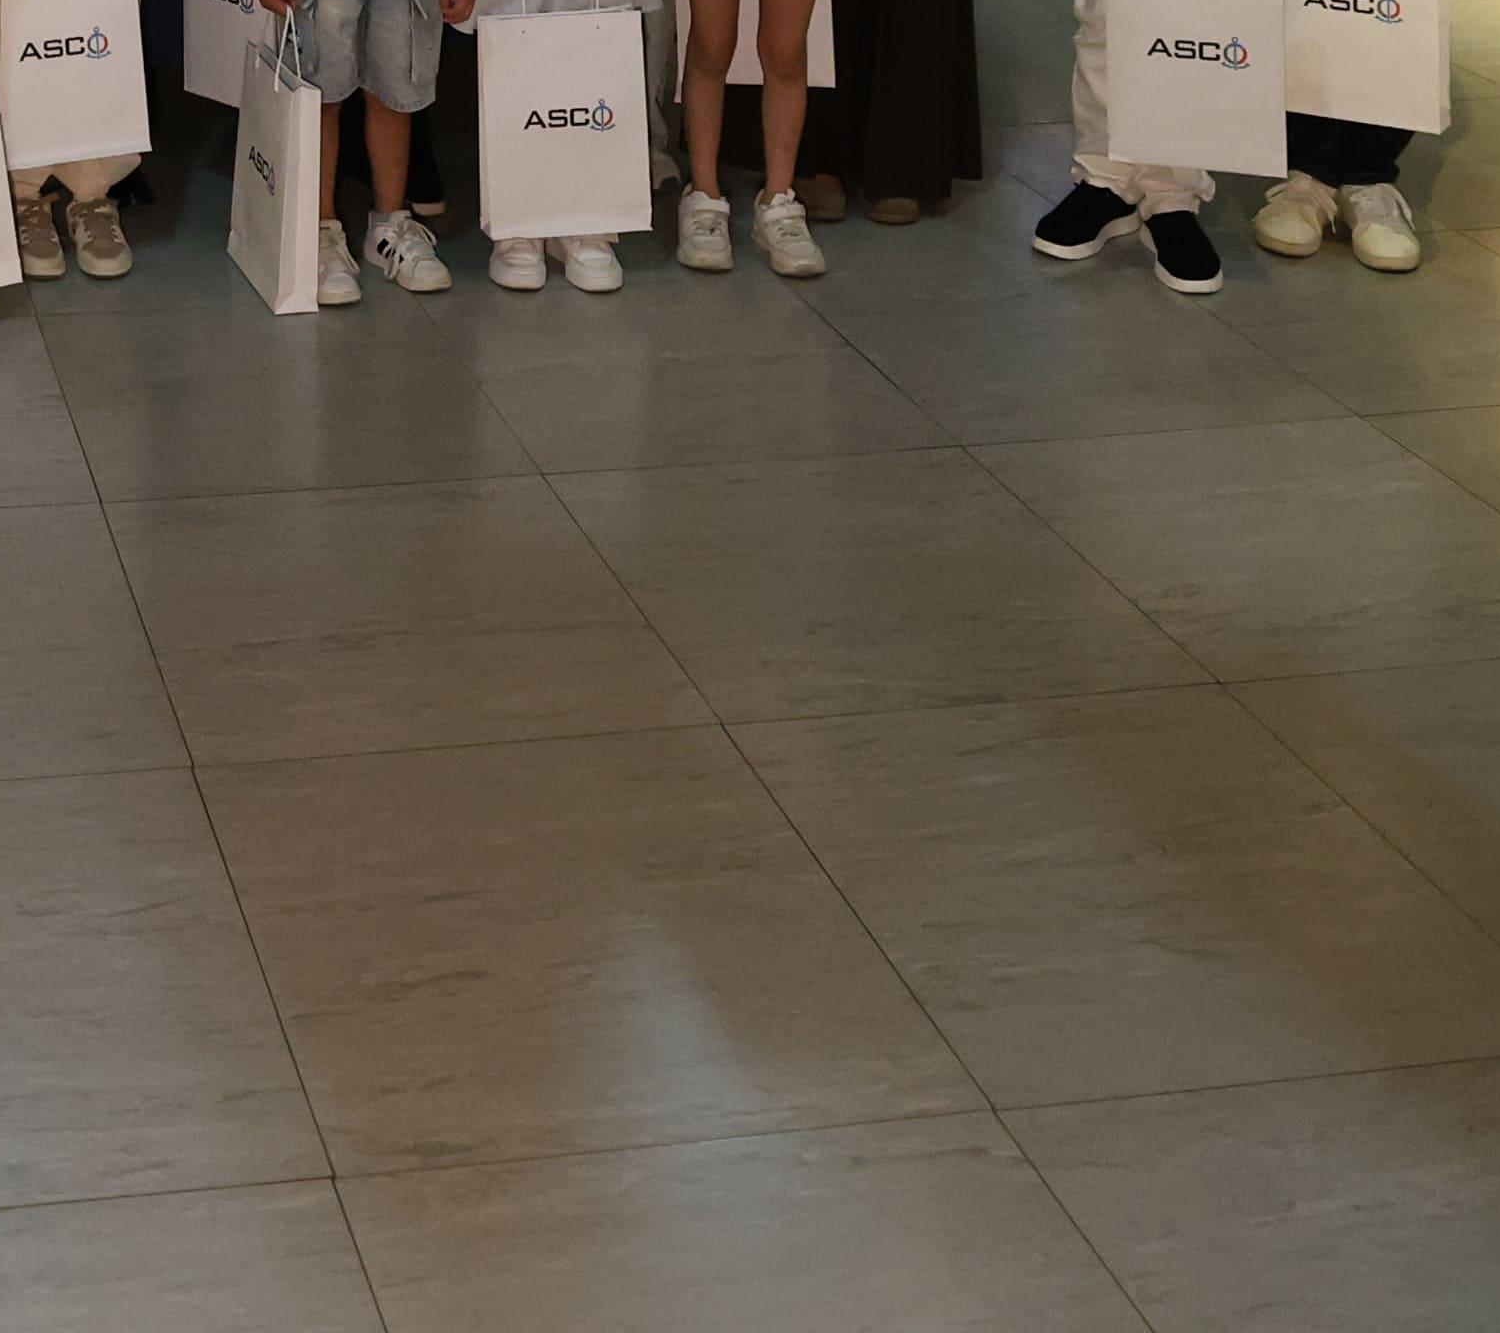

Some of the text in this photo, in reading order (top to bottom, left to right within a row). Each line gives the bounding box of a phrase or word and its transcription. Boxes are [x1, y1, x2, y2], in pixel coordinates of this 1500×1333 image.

[18, 26, 112, 63] ASCO
[1145, 36, 1252, 71] ASCO
[523, 98, 616, 133] ASCO
